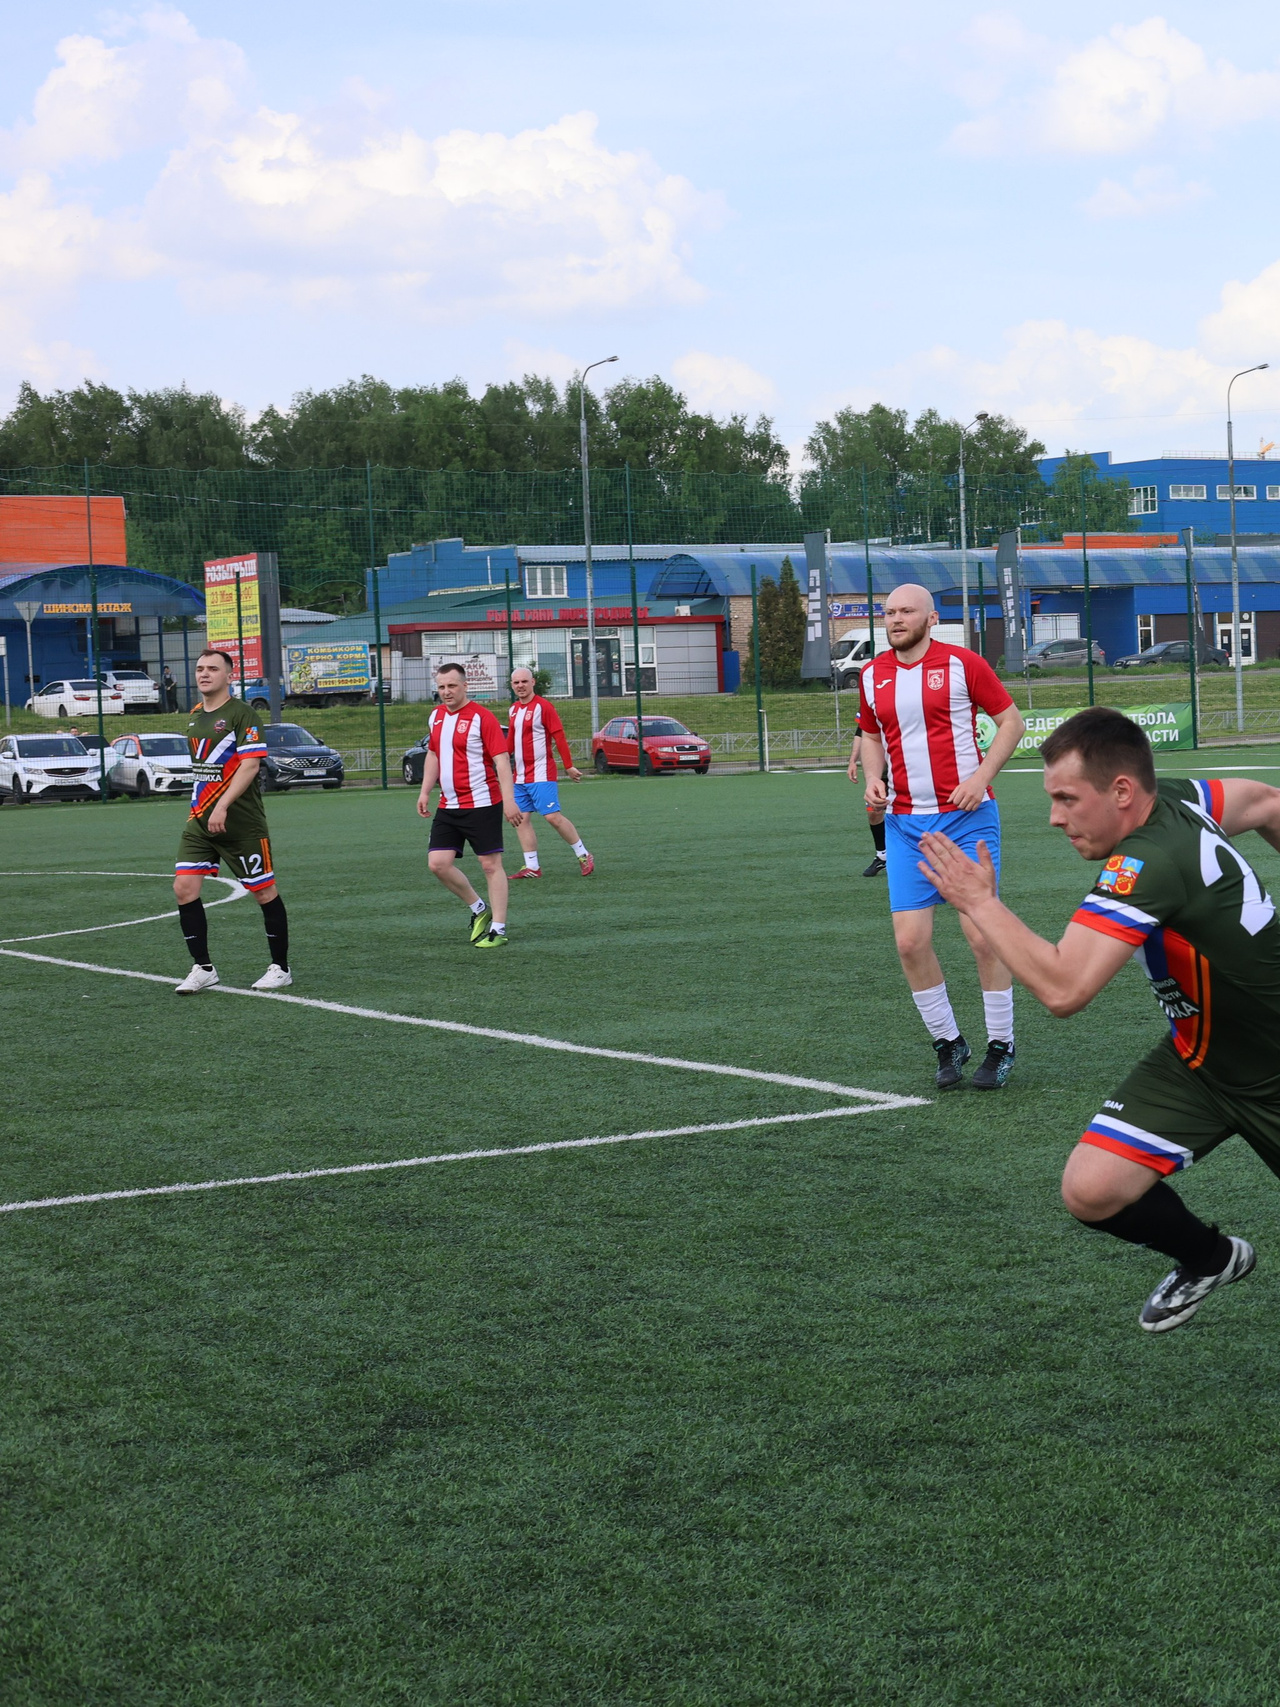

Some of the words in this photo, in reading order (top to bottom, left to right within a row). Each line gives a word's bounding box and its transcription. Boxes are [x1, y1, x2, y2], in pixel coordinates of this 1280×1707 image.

[205, 559, 257, 583] РОЗЫГРЫШ
[486, 609, 521, 622] РЫА
[559, 606, 649, 621] МОРЕРОДУКЫ
[307, 646, 363, 654] КОМБИКОРМ
[1130, 711, 1176, 726] ТБОЛА
[1147, 729, 1179, 743] АСТИ
[239, 853, 263, 875] 12
